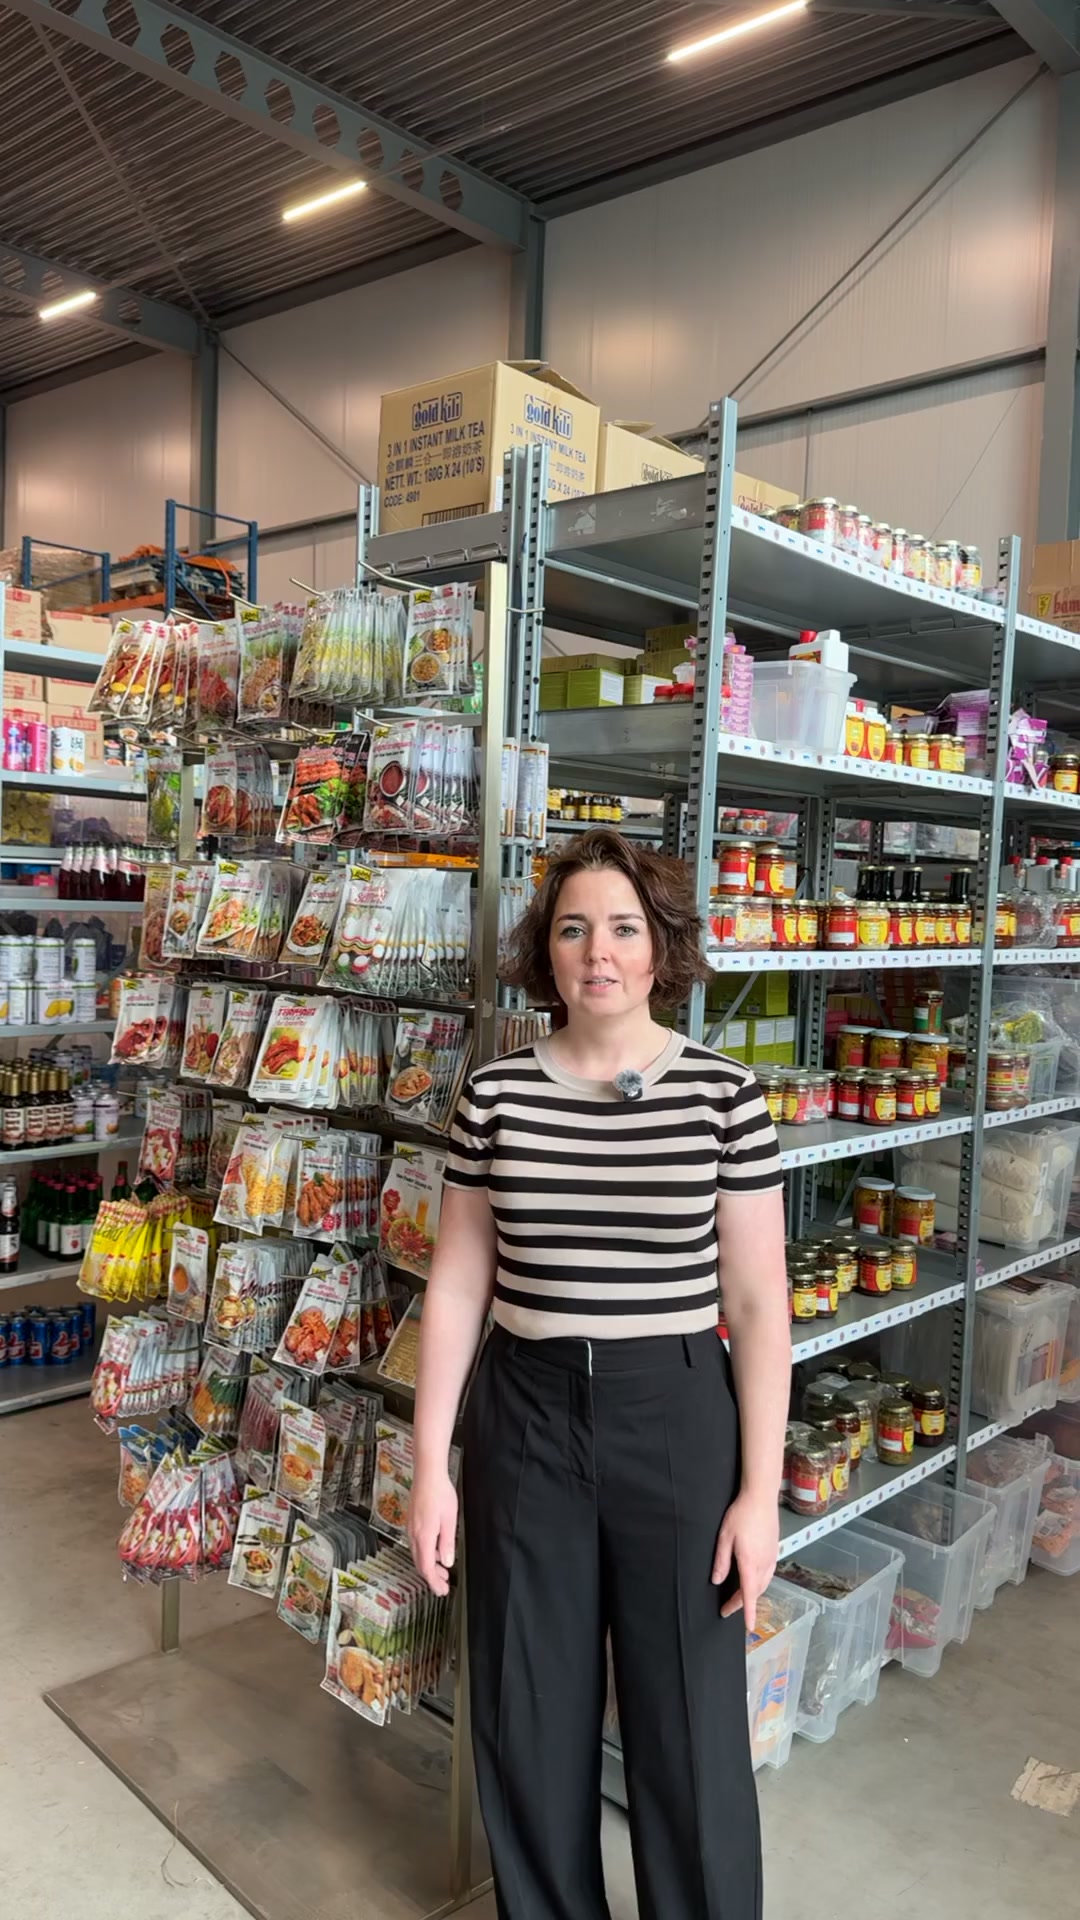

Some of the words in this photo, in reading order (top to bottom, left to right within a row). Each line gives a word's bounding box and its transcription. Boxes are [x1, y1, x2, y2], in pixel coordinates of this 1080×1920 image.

[415, 402, 438, 428] gold
[440, 395, 460, 422] kili
[527, 395, 551, 428] gold
[553, 405, 570, 437] kili
[387, 443, 392, 458] 3
[393, 441, 401, 456] IN
[403, 439, 408, 454] 1
[410, 430, 443, 453] INSTANT
[445, 424, 466, 443] MILK
[468, 420, 485, 439] TEA
[558, 443, 573, 458] MILK
[575, 450, 586, 463] TEA
[444, 463, 451, 480] X
[452, 460, 461, 478] 24
